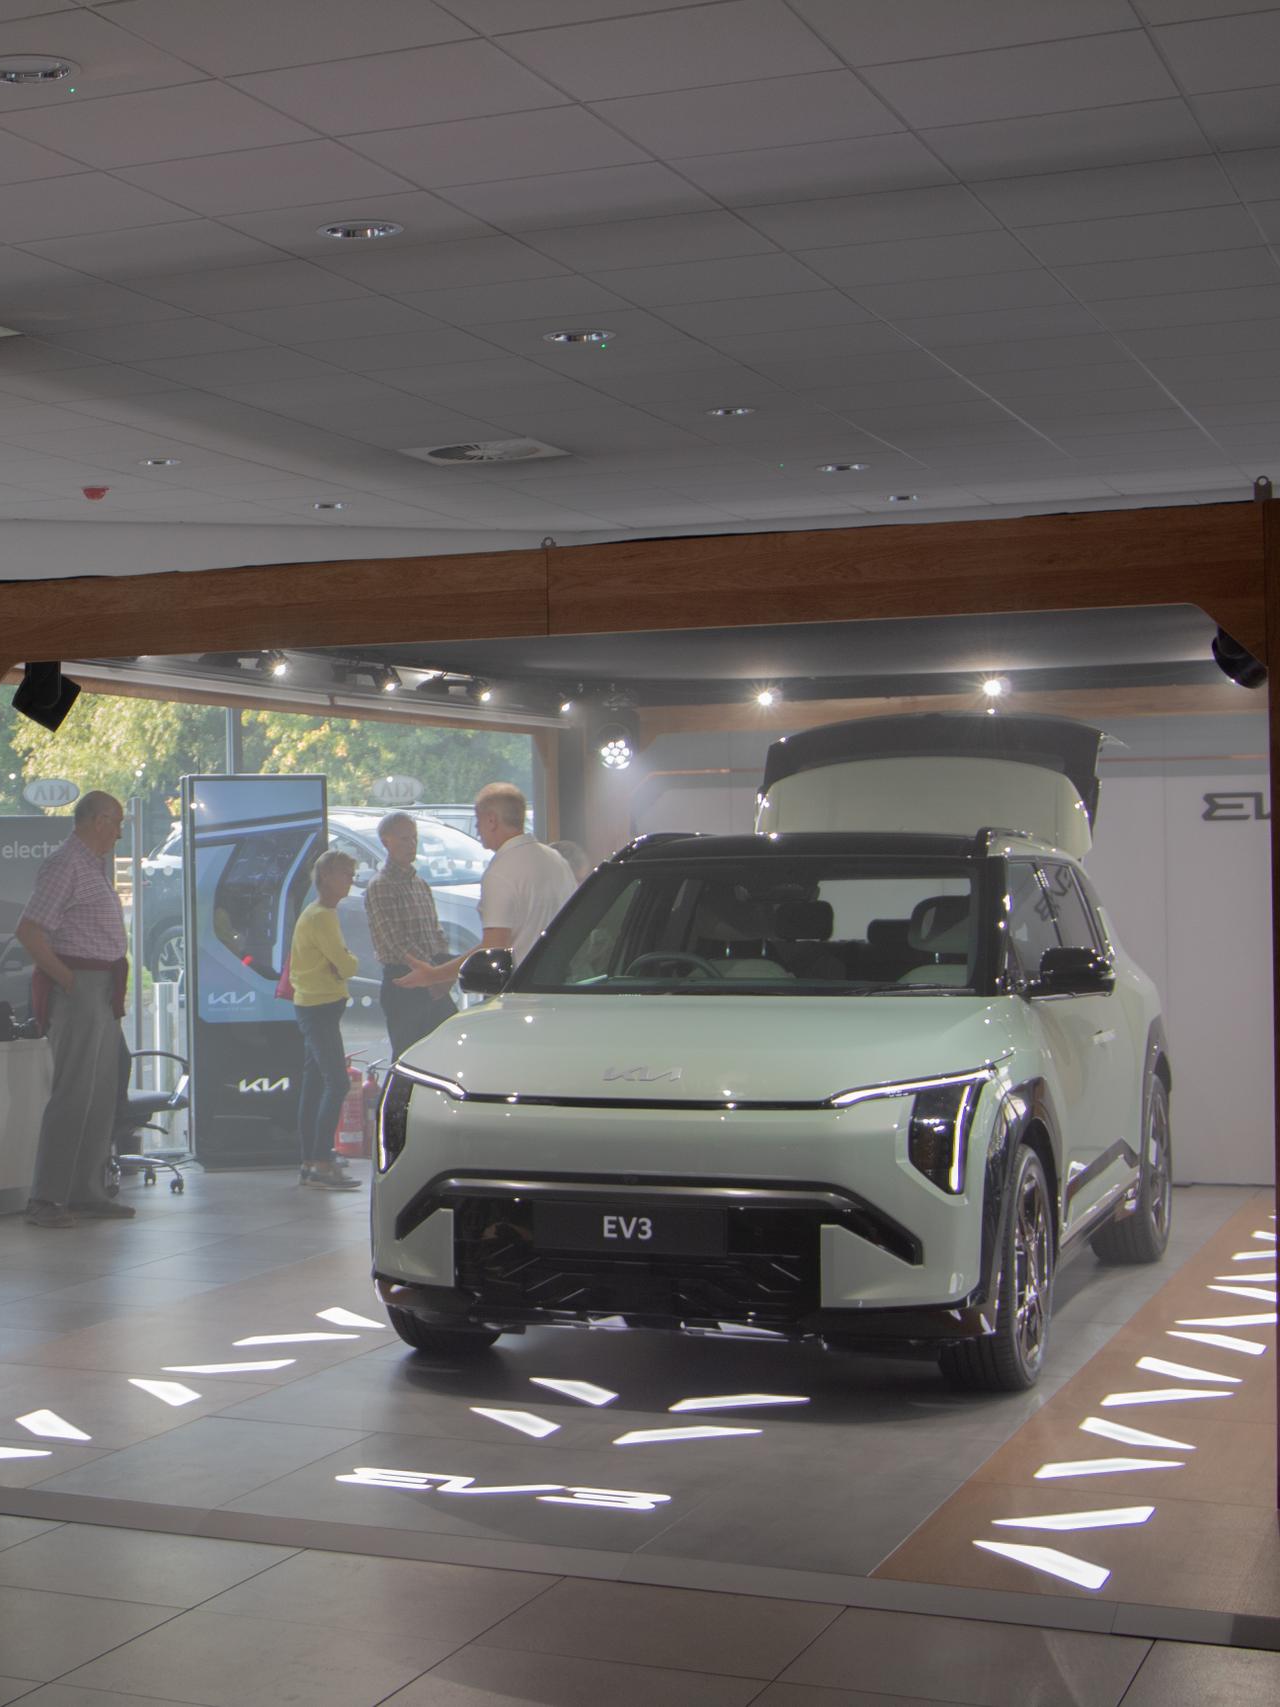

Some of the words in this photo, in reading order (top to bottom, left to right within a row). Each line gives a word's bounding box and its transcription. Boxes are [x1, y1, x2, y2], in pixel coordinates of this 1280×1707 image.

[207, 990, 257, 1005] KIA
[602, 1066, 683, 1082] KIA
[239, 1077, 290, 1093] KIA
[603, 1215, 652, 1239] EV3
[335, 1467, 671, 1510] EV3
